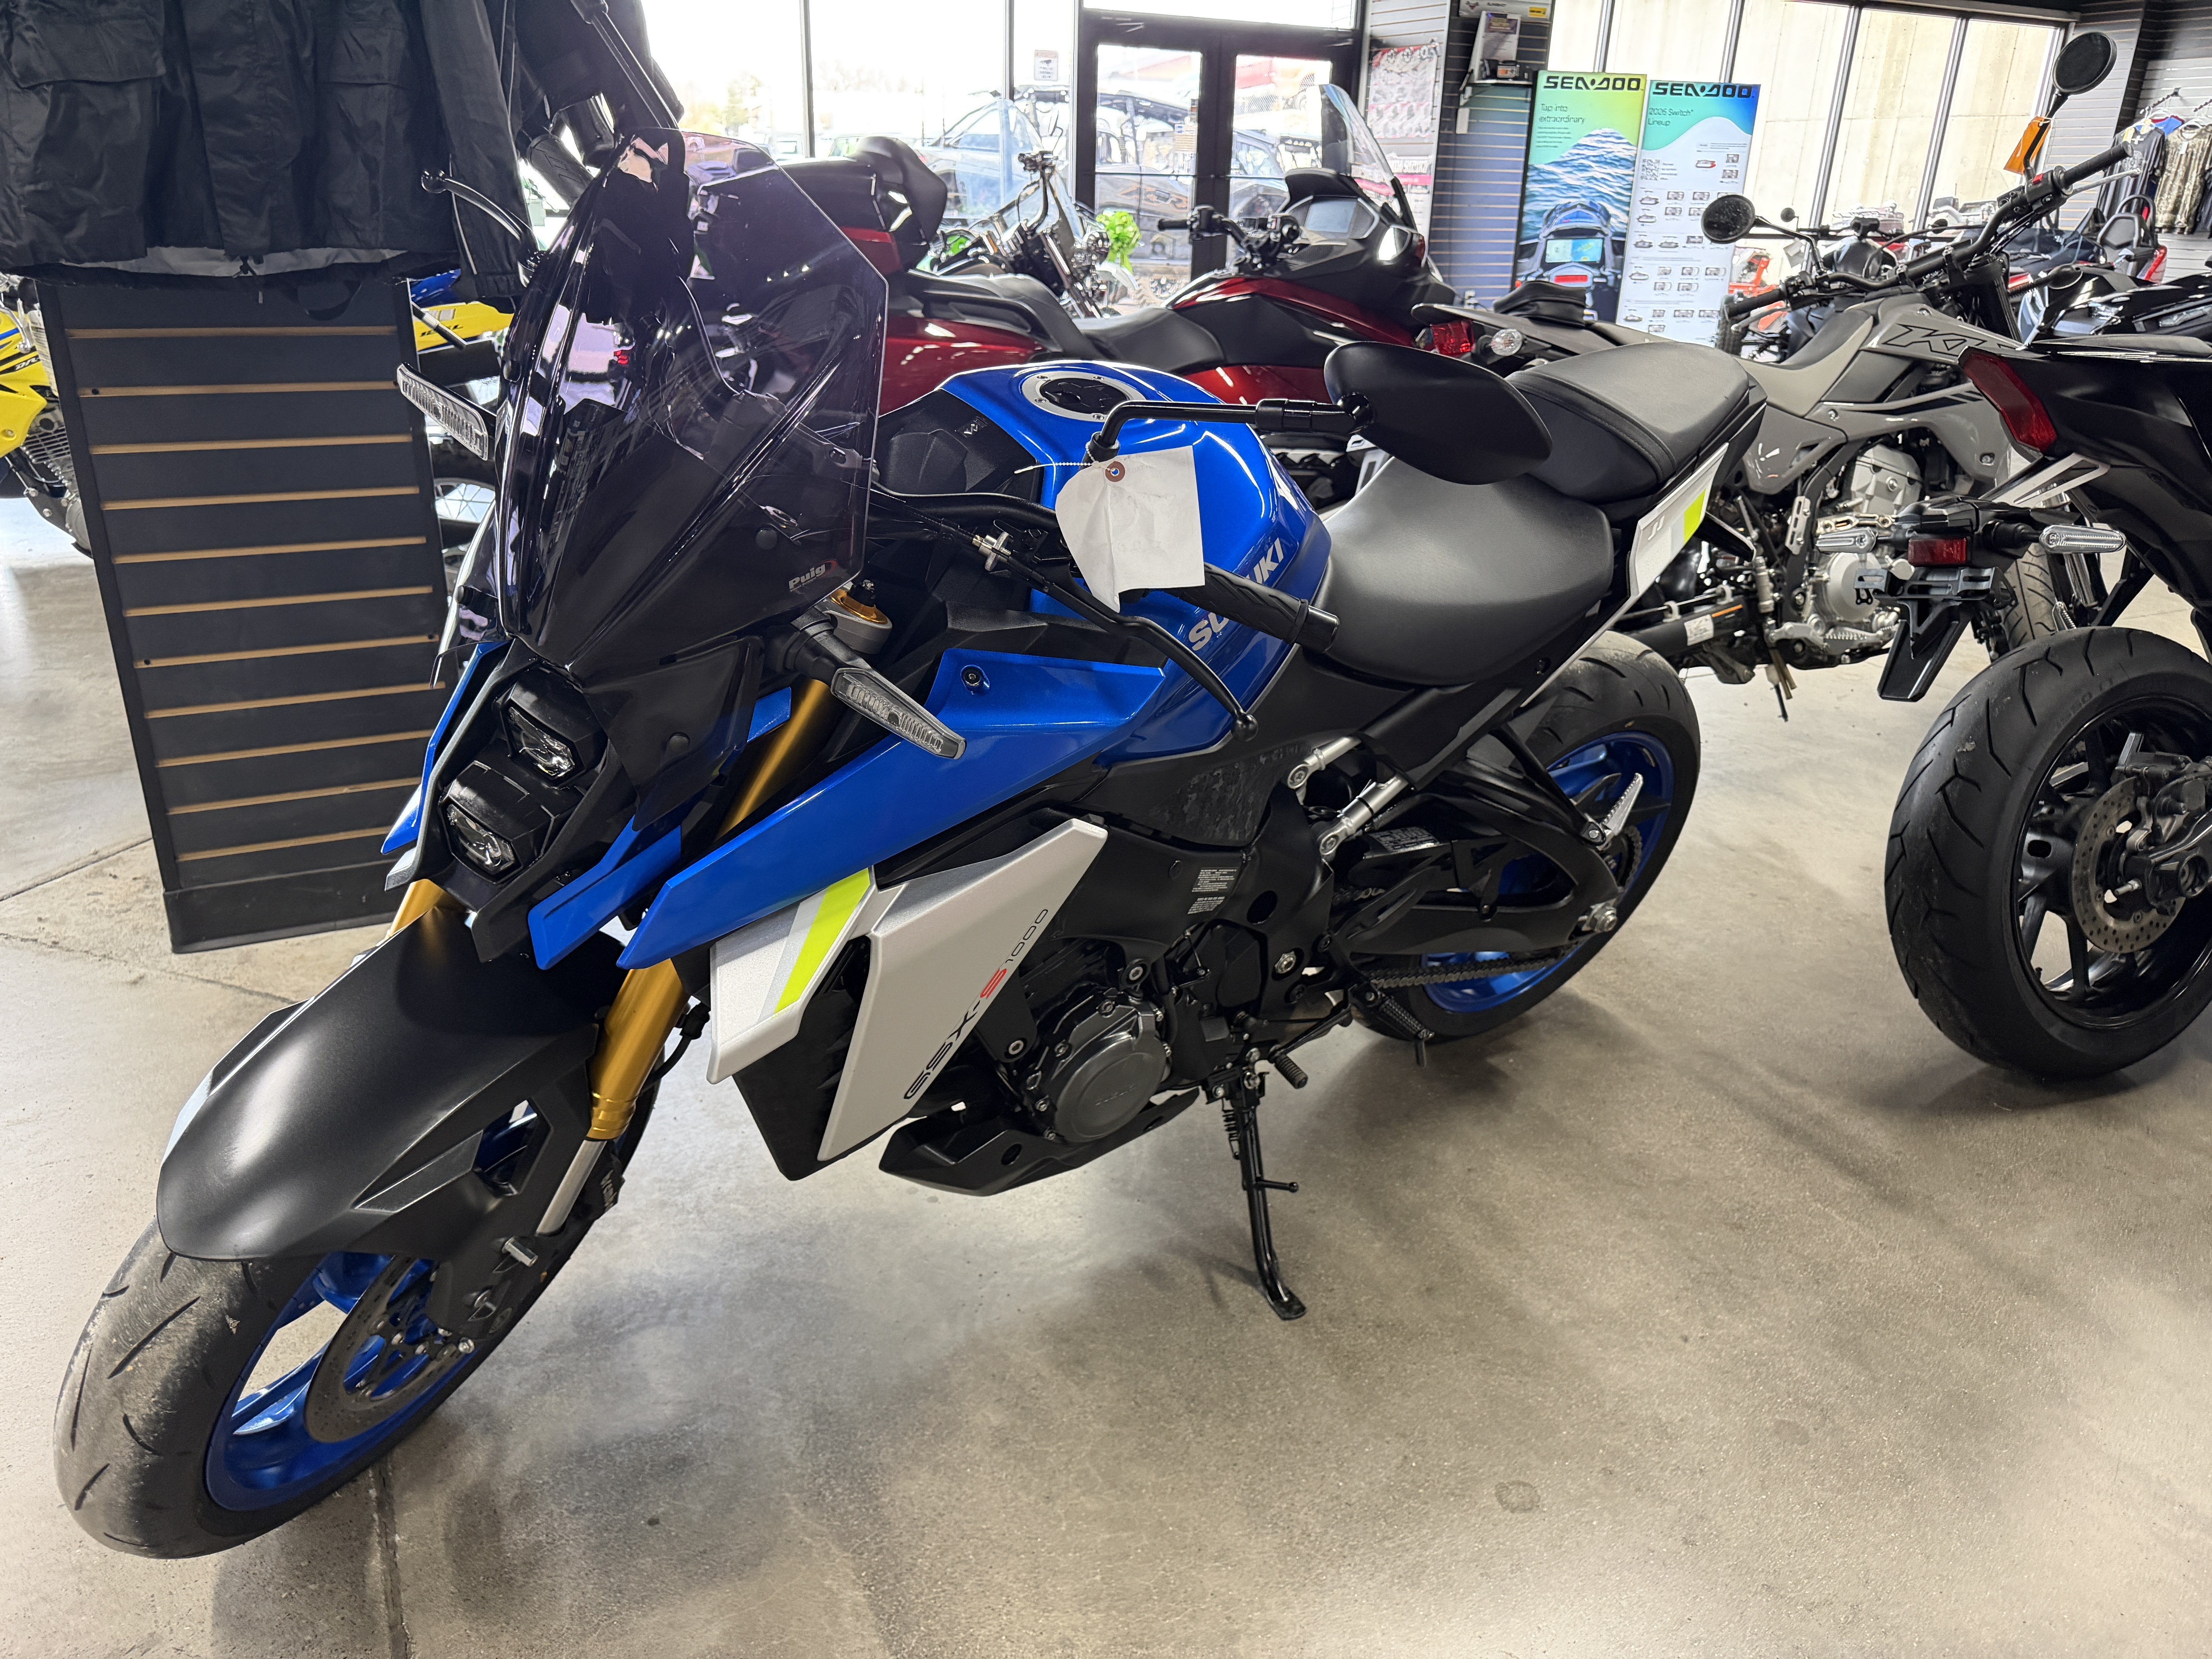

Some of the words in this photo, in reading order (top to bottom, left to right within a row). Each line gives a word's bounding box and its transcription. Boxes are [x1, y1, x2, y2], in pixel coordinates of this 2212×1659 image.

[1541, 103, 1553, 112] Tap
[1554, 103, 1568, 112] into
[1539, 115, 1586, 125] extraordinary
[1648, 118, 1670, 127] Lineup
[788, 564, 826, 590] Puig
[1188, 537, 1284, 651] SUUKI
